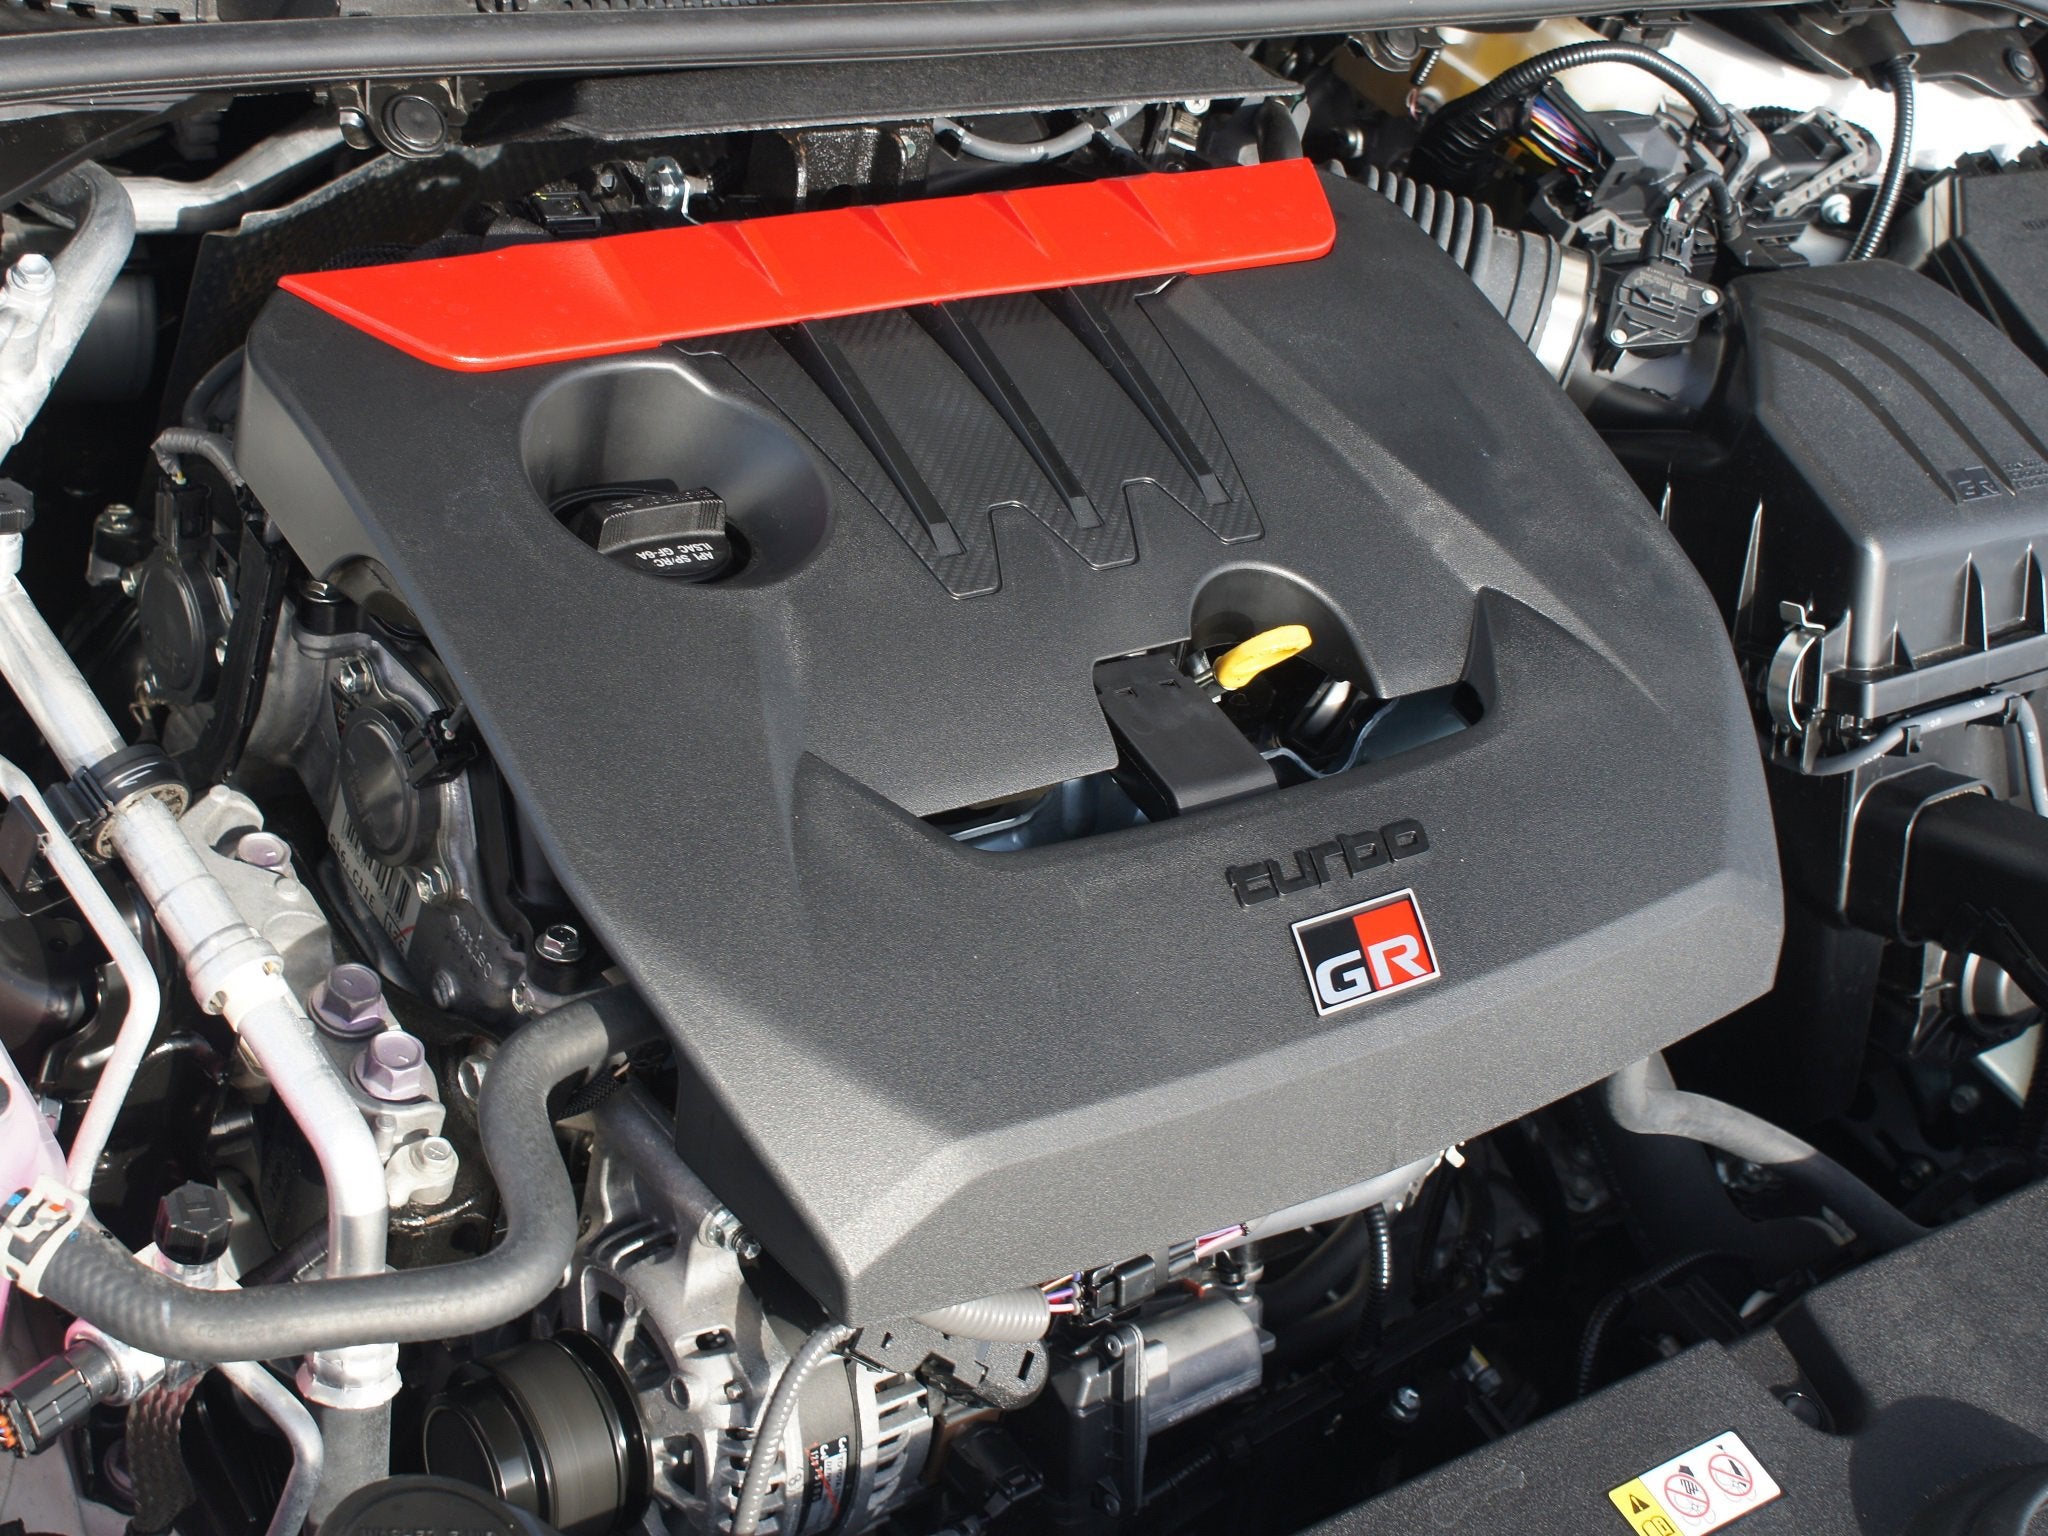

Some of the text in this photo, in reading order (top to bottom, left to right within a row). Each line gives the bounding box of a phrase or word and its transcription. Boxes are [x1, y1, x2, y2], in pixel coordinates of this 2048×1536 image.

[637, 542, 714, 560] ILSAC GF-6A
[655, 552, 714, 567] API SP/RC
[1224, 817, 1431, 908] turbo
[1315, 935, 1427, 1005] GR
